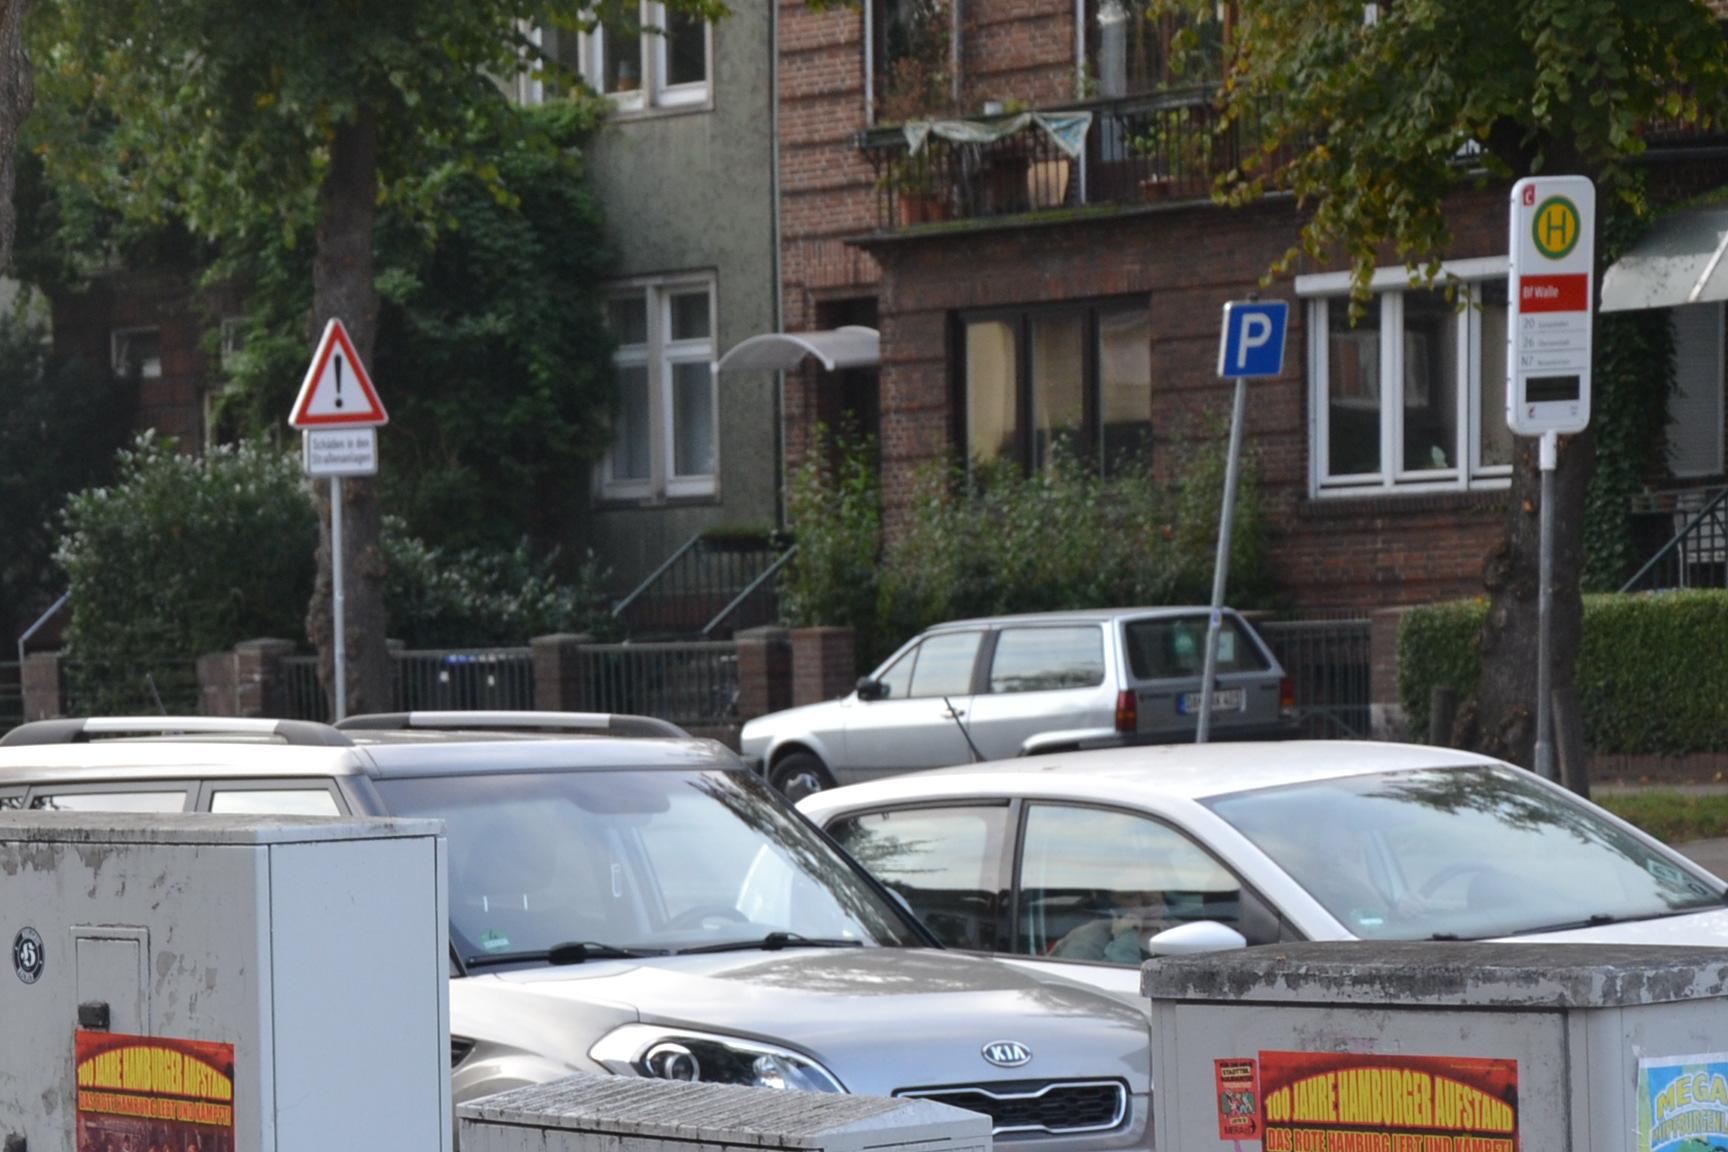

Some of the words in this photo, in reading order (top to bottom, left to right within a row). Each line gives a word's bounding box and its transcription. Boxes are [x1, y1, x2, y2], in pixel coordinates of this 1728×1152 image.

[1547, 209, 1566, 246] H
[1523, 286, 1534, 299] Bf
[1535, 285, 1560, 299] Walle
[1237, 312, 1272, 369] P
[1523, 318, 1535, 329] 20
[990, 1045, 1026, 1061] KIA
[94, 1048, 123, 1088] JAHRE
[123, 1046, 183, 1093] HAMBURGER
[183, 1055, 232, 1101] AUFSTAND
[1265, 1086, 1290, 1122] 100
[1293, 1072, 1338, 1122] JAHRE
[1337, 1068, 1432, 1126] HAMBURGER
[1435, 1074, 1514, 1132] AUFSTAND
[1656, 1074, 1728, 1121] MEGA
[1266, 1127, 1293, 1152] DAS
